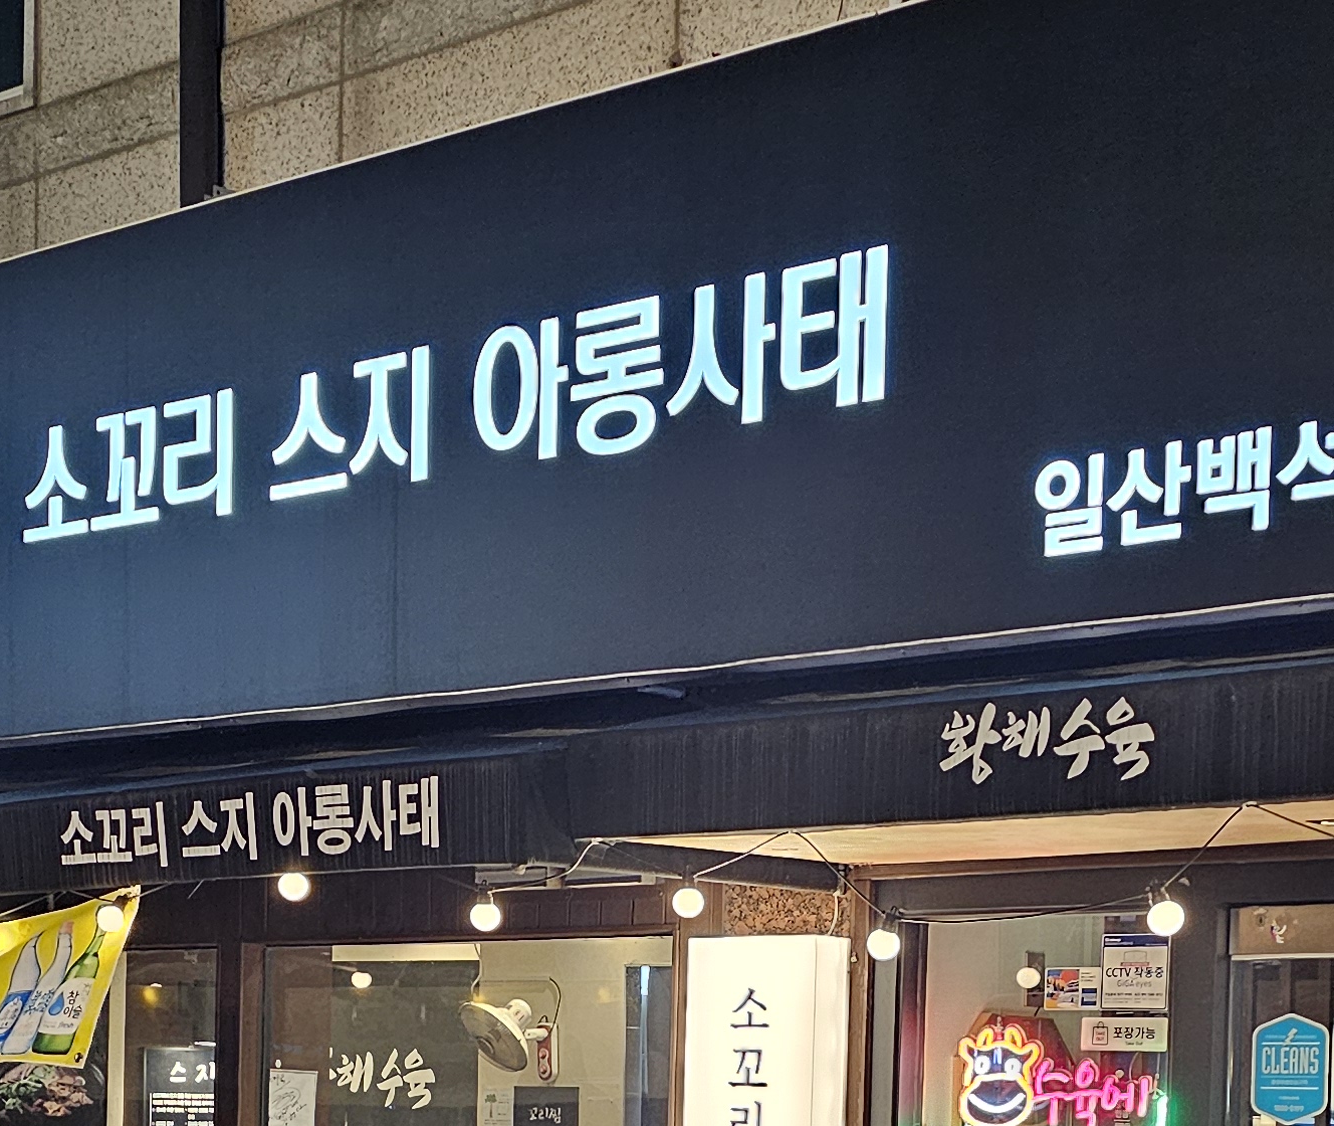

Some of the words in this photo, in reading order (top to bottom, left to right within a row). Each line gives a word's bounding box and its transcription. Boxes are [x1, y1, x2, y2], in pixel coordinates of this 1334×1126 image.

[22, 387, 234, 544] 소꼬리
[269, 344, 432, 501] 스지
[472, 243, 890, 460] 아롱사태
[60, 801, 169, 868] 소꼬리
[181, 791, 258, 861] 스지
[272, 775, 440, 857] 아롱사태
[1105, 967, 1131, 978] CCTV
[1134, 966, 1164, 979] 작동중
[1113, 1026, 1156, 1040] 포장가능
[329, 1047, 436, 1110] 해수육
[1261, 1046, 1320, 1075] CLEANS
